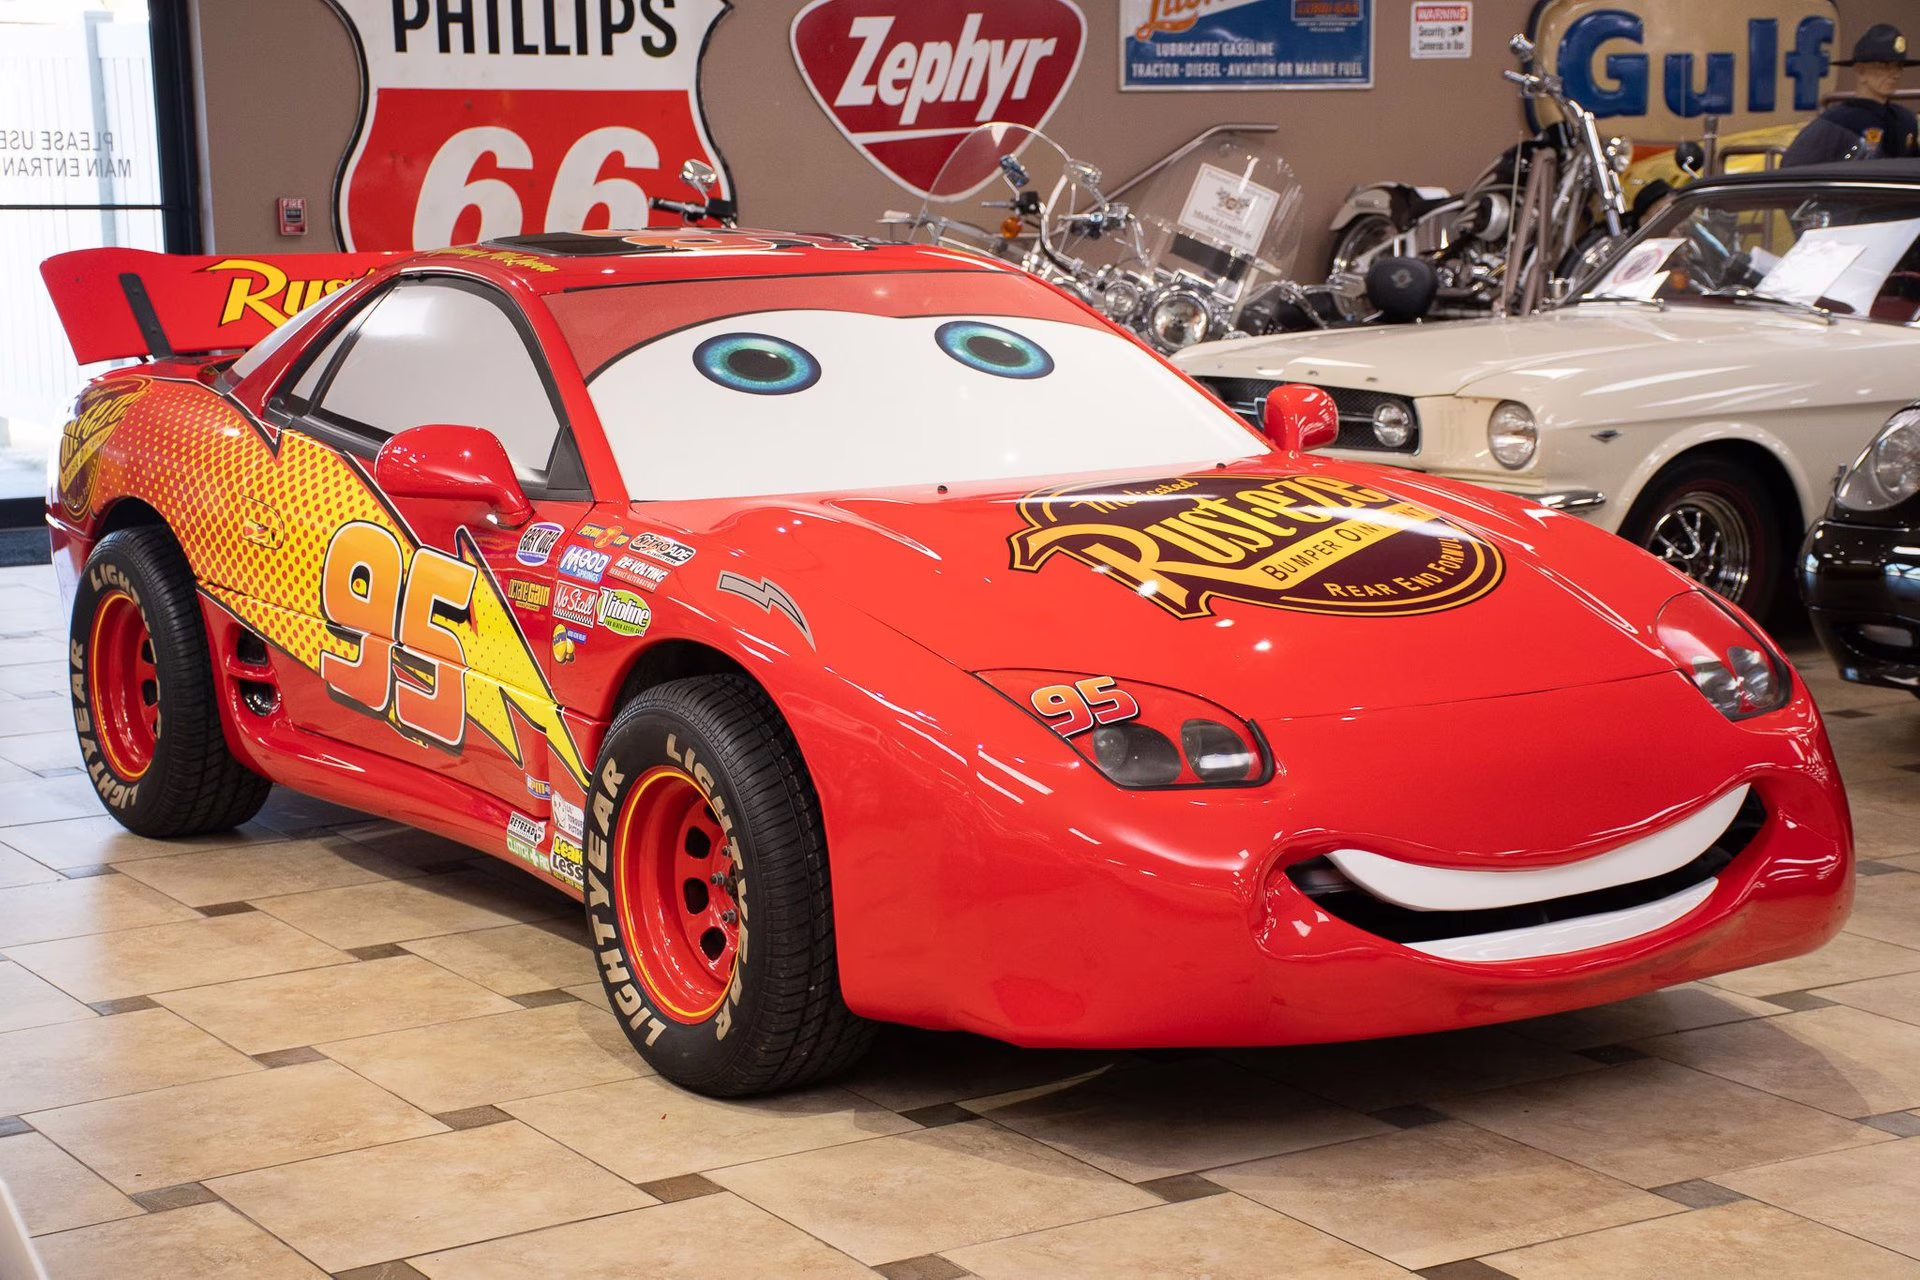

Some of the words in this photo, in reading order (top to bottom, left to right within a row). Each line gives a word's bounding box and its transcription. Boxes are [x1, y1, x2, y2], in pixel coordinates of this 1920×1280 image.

[392, 0, 677, 57] PHILLIPS
[1155, 41, 1221, 57] LUBRICATED
[1221, 41, 1275, 57] GASOLINE
[834, 12, 1058, 125] Zephyr
[1131, 62, 1180, 78] TRACTOR
[1184, 62, 1222, 77] DIESEL
[1226, 62, 1277, 77] AVIATION
[1276, 62, 1293, 76] OR
[1294, 61, 1338, 77] MARINE
[1337, 61, 1363, 76] FUEL
[1557, 10, 1836, 119] Gulf
[412, 126, 660, 251] 66
[1260, 538, 1343, 582] BUMPER
[1334, 505, 1428, 542] OINNT
[1322, 581, 1398, 598] REAR
[1391, 575, 1444, 593] END
[1426, 537, 1466, 576] FORMUL
[320, 520, 478, 748] 95
[556, 586, 569, 608] No
[567, 587, 596, 616] Stall
[598, 587, 650, 628] Vitoline
[71, 637, 139, 809] LIGHTYEAR
[1031, 676, 1140, 739] 95
[588, 757, 667, 1047] LIGHTYEAR
